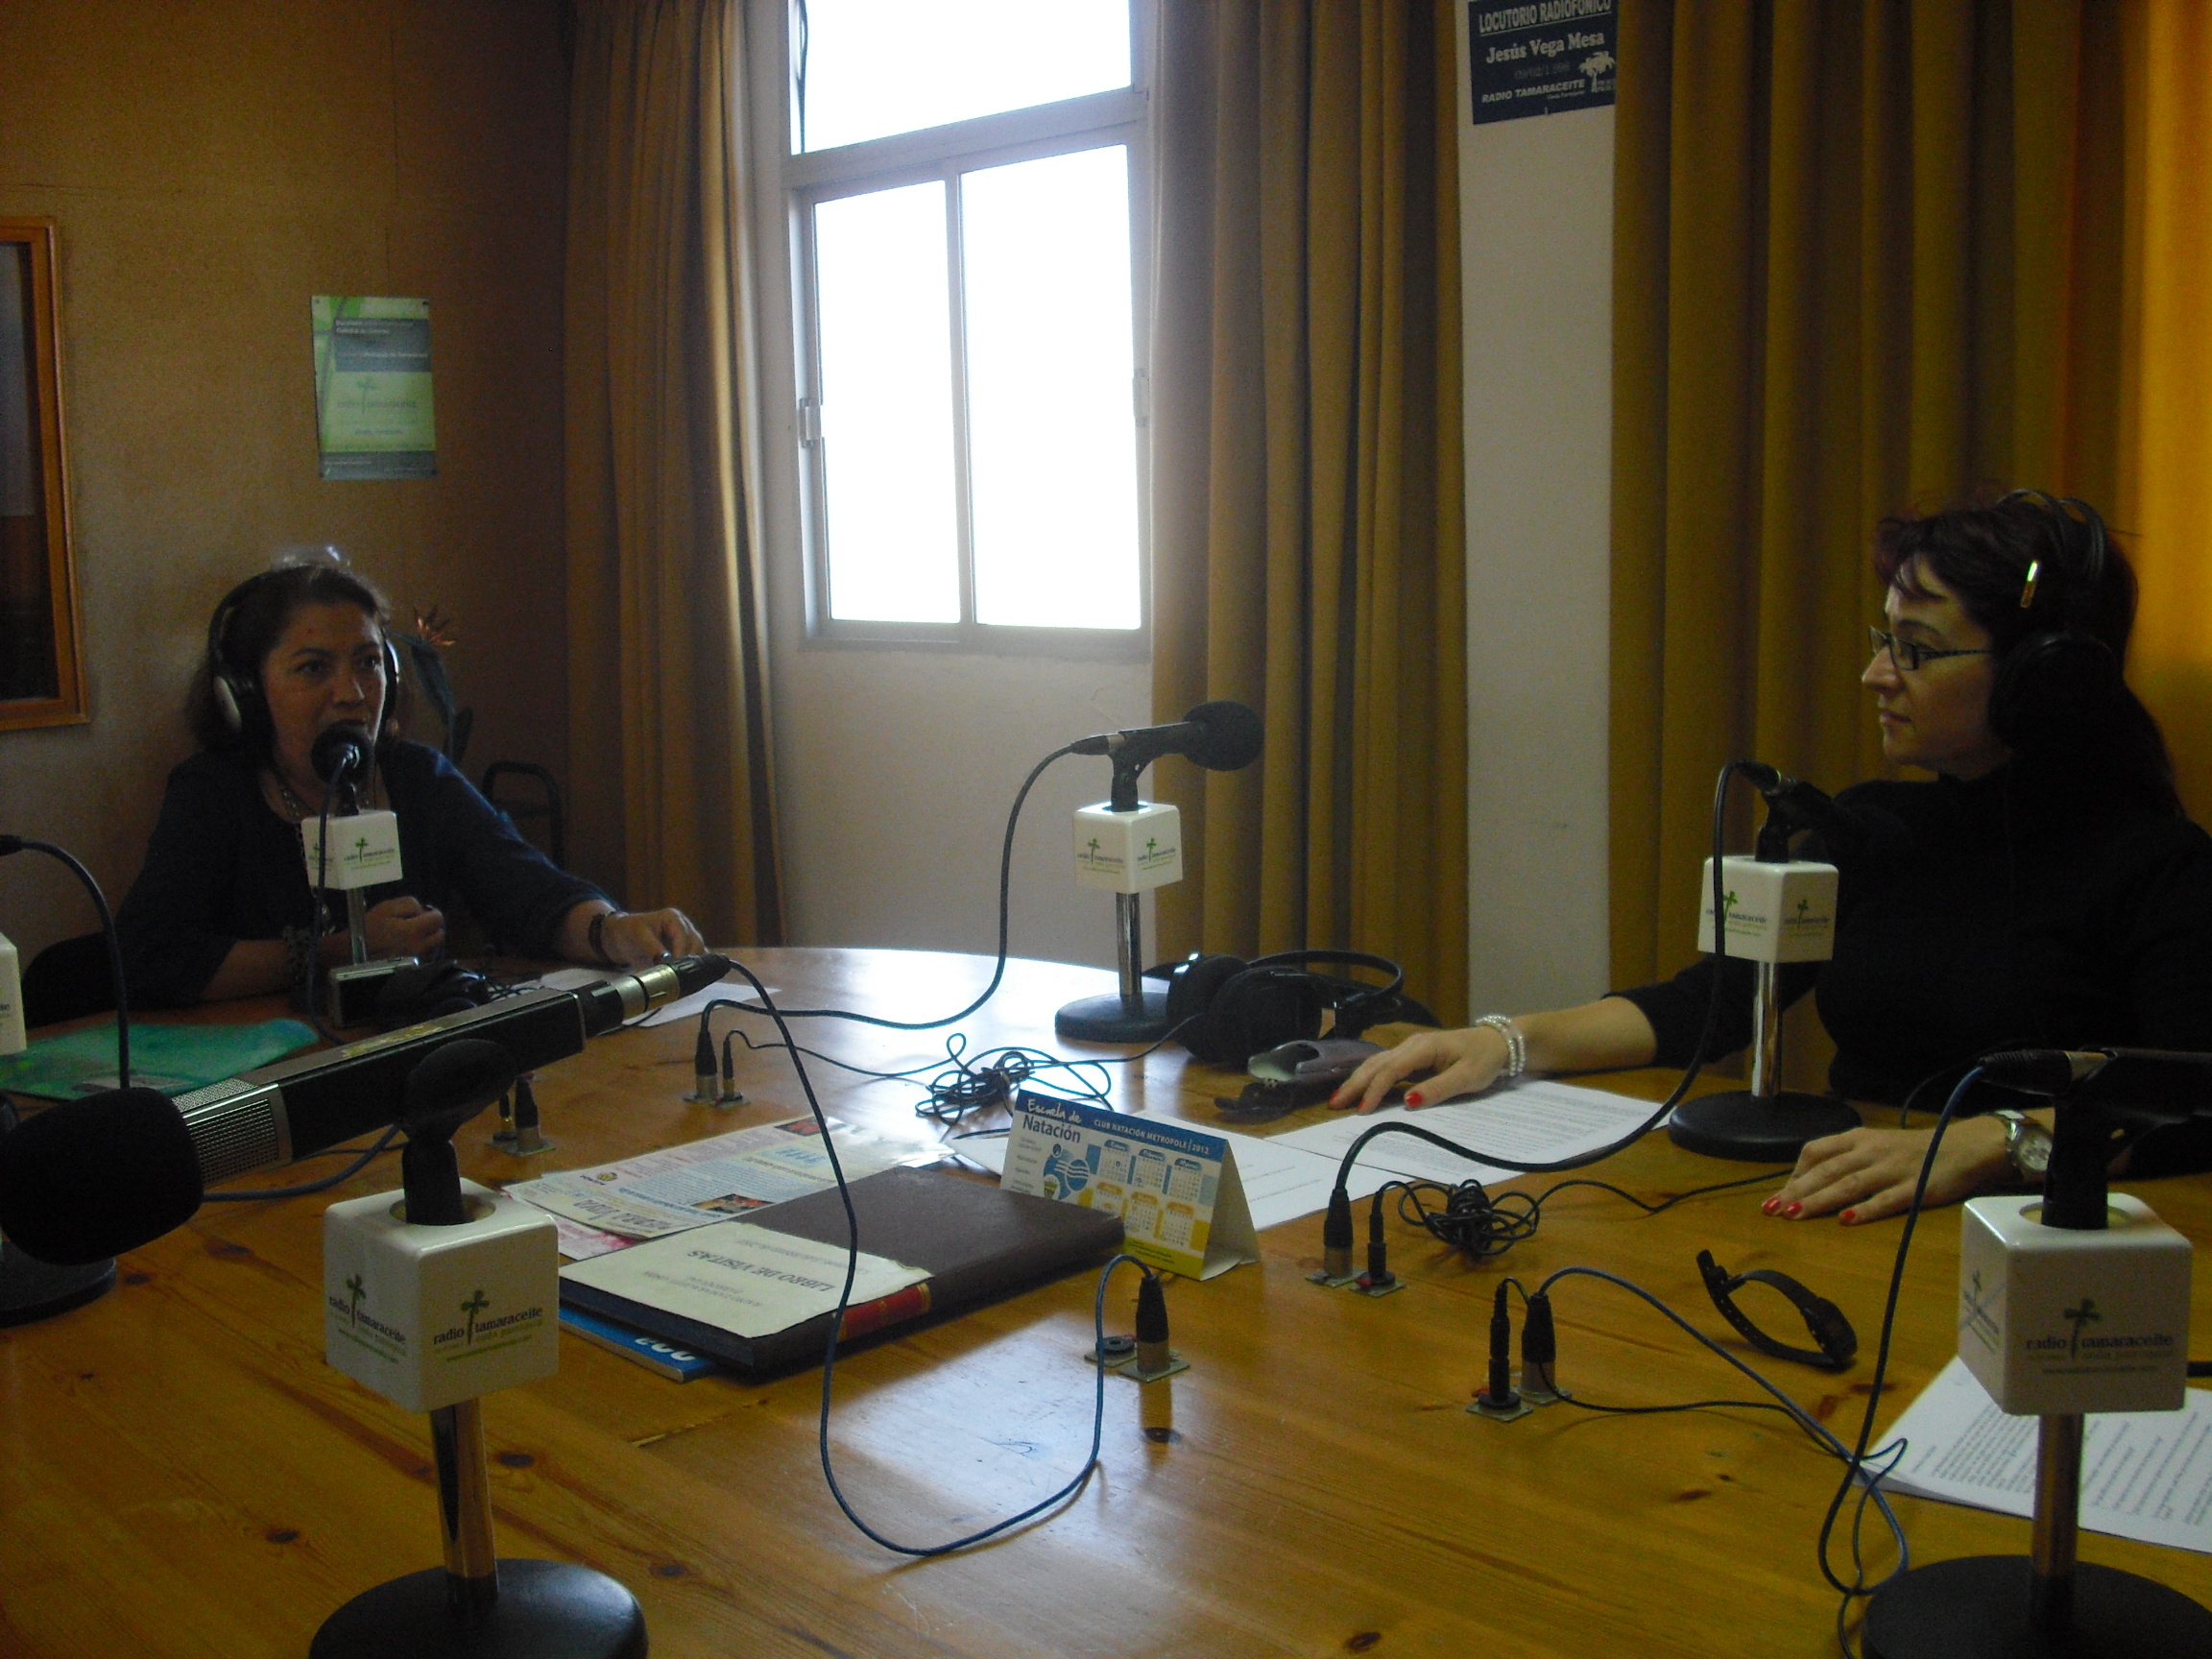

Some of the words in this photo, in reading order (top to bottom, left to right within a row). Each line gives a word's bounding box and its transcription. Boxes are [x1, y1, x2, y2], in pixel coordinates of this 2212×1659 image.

[1479, 5, 1536, 34] LOCUTORIO
[1486, 42, 1527, 63] Jesús
[1528, 38, 1565, 58] Vega
[1568, 32, 1605, 51] Mesa
[1481, 90, 1513, 104] RADIO
[1514, 79, 1585, 97] TAMARACEITE
[1026, 1097, 1068, 1120] Escuela
[1068, 1111, 1082, 1124] de
[1022, 1114, 1081, 1143] Natación
[1094, 1118, 1112, 1130] CLUB
[1112, 1122, 1146, 1139] NATACIÓN
[1146, 1131, 1188, 1150] METROPOLE
[1191, 1143, 1210, 1155] 2012
[686, 1249, 750, 1272] VISITAS
[750, 1265, 781, 1280] DE
[779, 1273, 836, 1293] LIBRO
[434, 1324, 466, 1345] radio
[475, 1306, 543, 1334] tamaraceite
